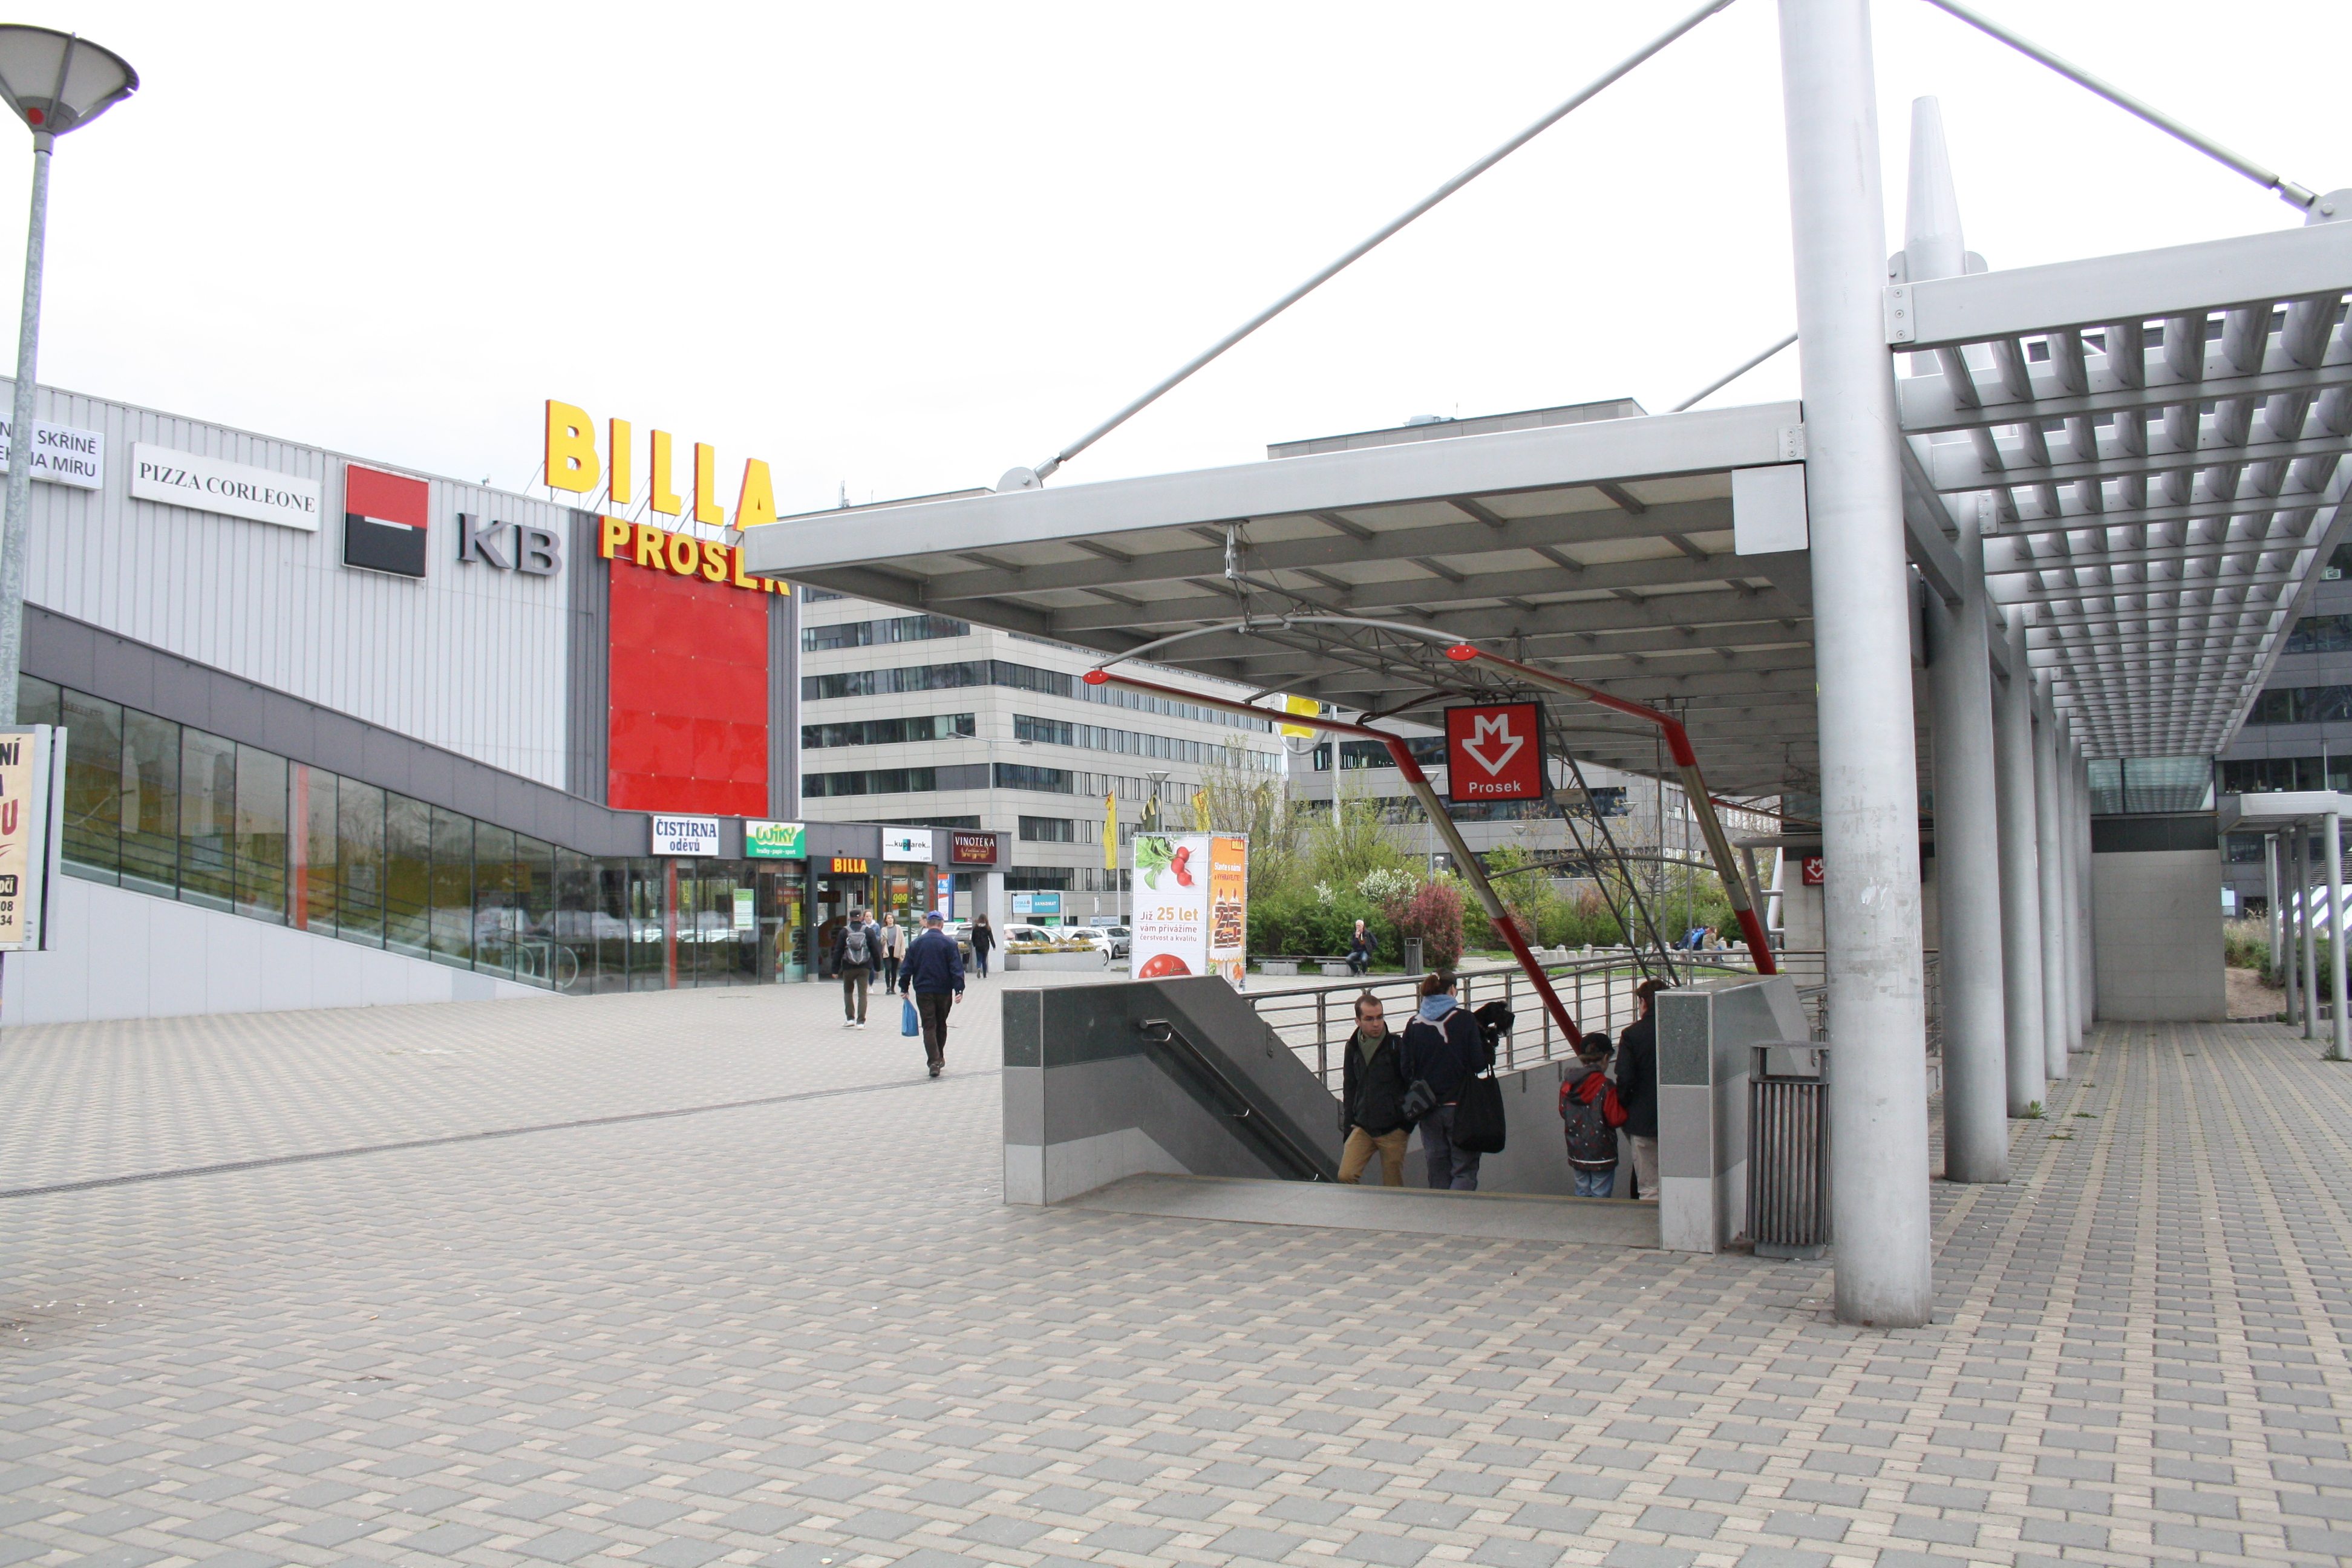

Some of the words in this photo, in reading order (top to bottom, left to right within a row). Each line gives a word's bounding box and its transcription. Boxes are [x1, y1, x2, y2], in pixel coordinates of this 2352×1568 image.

[38, 430, 96, 455] SKŘÍNĚ
[53, 456, 96, 477] MÍRU
[544, 399, 777, 531] BILLA
[139, 462, 201, 490] PIZZA
[207, 476, 316, 513] CORLEONE
[457, 512, 562, 576] KB
[1469, 780, 1521, 794] Prosek
[656, 818, 717, 838] ČISTÍRNA
[670, 838, 701, 852] oděvů
[955, 835, 995, 847] VINOTÉKA
[1232, 840, 1244, 850] BILLA
[831, 858, 867, 873] BILLA
[1214, 862, 1227, 871] Slavte
[1230, 863, 1241, 872] námi
[1140, 910, 1153, 920] Již
[1157, 907, 1174, 921] 25
[1178, 907, 1198, 921] let
[1140, 924, 1156, 932] vám
[1158, 924, 1197, 934] přivážíme
